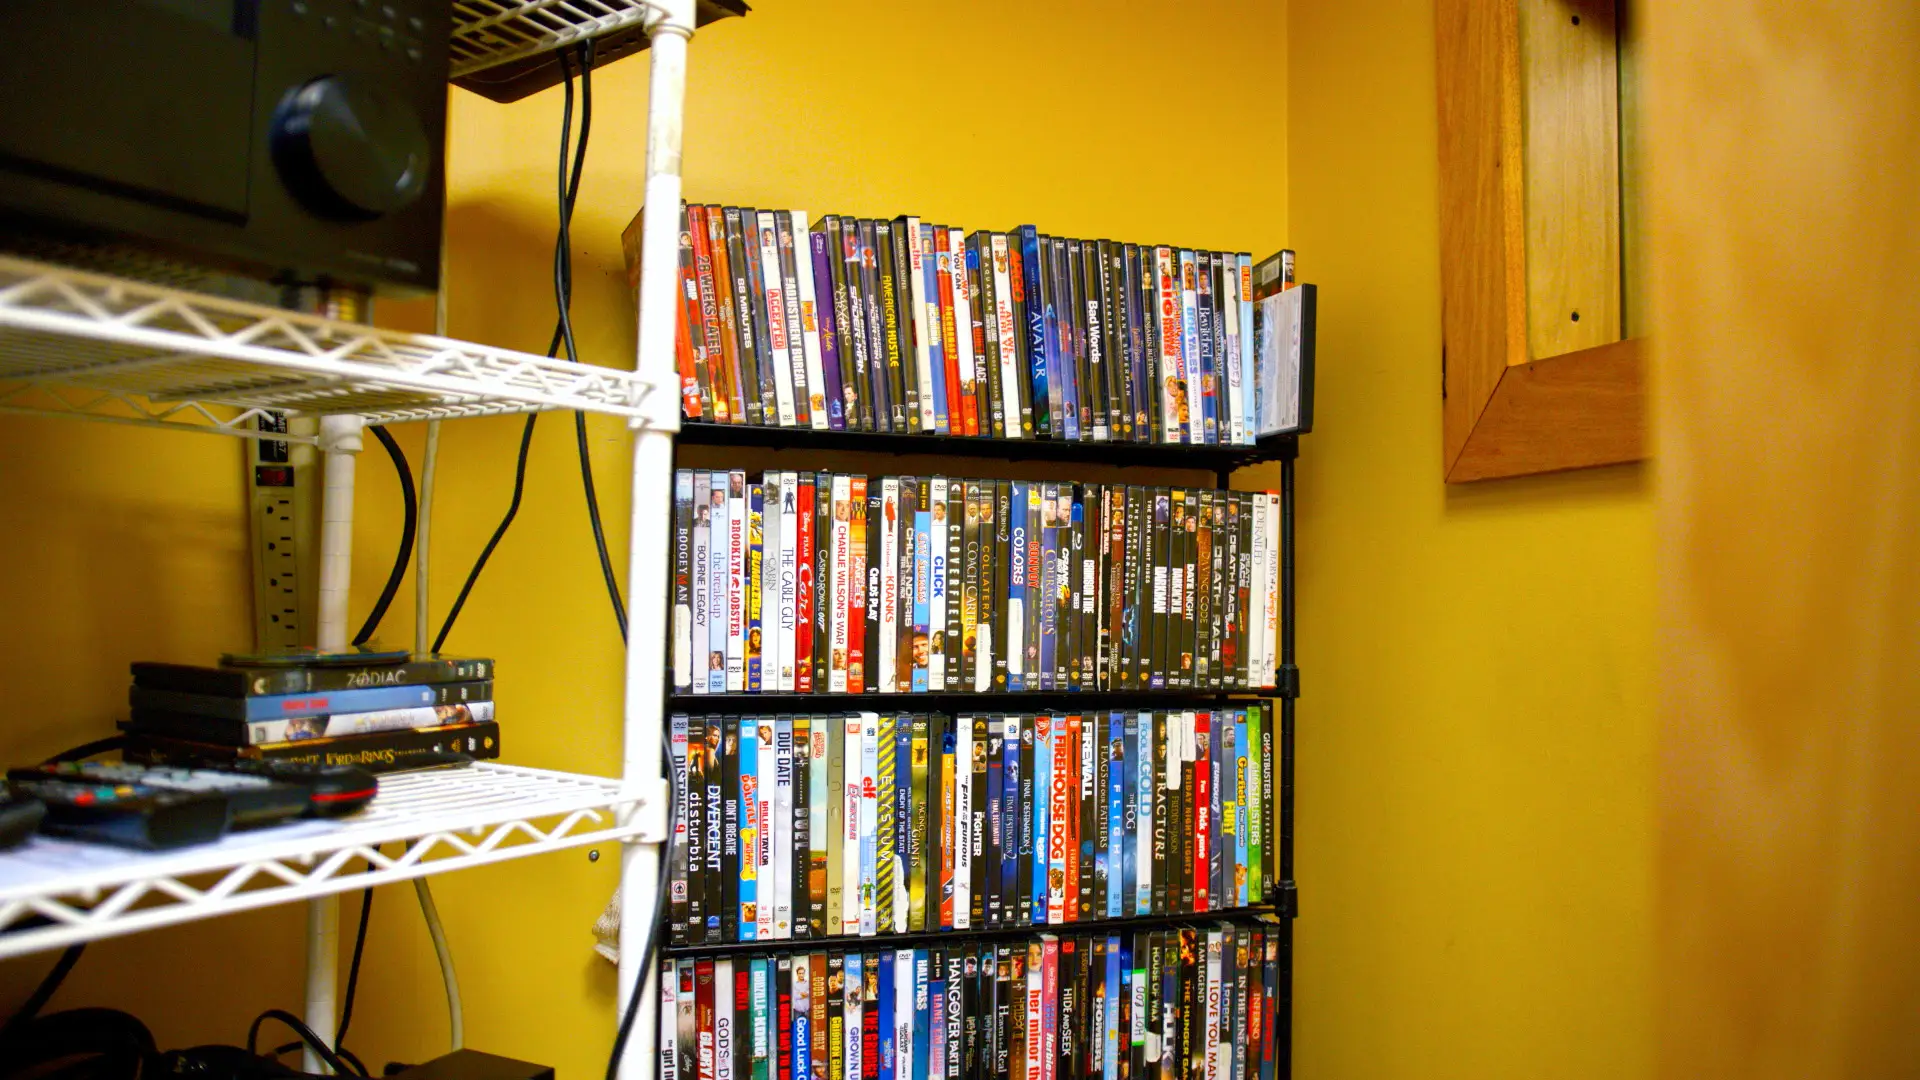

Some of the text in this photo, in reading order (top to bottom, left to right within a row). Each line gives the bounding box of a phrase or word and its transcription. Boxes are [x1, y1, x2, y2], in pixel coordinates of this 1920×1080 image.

[913, 250, 922, 270] that
[1009, 249, 1024, 302] ARGO
[697, 256, 722, 355] 28 WEEKS LATER
[740, 296, 751, 348] MINUTES
[770, 291, 785, 348] ACCEPTED
[850, 285, 864, 373] SPIDER-MAN
[882, 275, 899, 367] AMERICAN HUSTLE
[1088, 300, 1101, 364] Bad Words
[1199, 307, 1213, 357] Bewitched
[1214, 311, 1222, 341] WAKANDA
[785, 283, 805, 387] ADJUSTMENT BUREAU
[1030, 311, 1046, 379] AVATAR
[1188, 337, 1198, 374] TALES
[975, 355, 986, 384] PLACE
[678, 528, 688, 601] BOOGEYMAN
[730, 519, 740, 637] BROOKLYN LOBSTER
[933, 556, 943, 598] CLICK
[948, 525, 960, 637] CLOVERFIELD
[1013, 527, 1024, 584] COLORS
[1028, 541, 1039, 589] CONVOY
[696, 545, 705, 626] BOURNE LEGACY
[710, 552, 722, 618] the break-up
[751, 550, 761, 620] BUMBLEBEE
[782, 547, 793, 631] THE CABLE GUY
[799, 563, 812, 626] Cars
[836, 526, 846, 644] CHARLIE WILSON'S WAR
[867, 567, 879, 621] CHILD'S PLAY
[885, 576, 894, 622] KRANKS
[905, 581, 913, 626] NORRIS
[966, 541, 978, 631] COACH CARTER
[1044, 549, 1056, 635] COURAGEOUS
[1083, 560, 1094, 614] CRIMSON TIDE
[1153, 567, 1167, 613] DARKMAN
[1185, 564, 1195, 621] DATE NIGHT
[1200, 596, 1208, 624] CODE
[1212, 546, 1222, 661] DEATH RACE
[346, 669, 407, 687] ZODIAC
[326, 753, 352, 766] LORD
[361, 749, 395, 764] RINGS
[778, 732, 790, 786] DUE DATE
[1082, 721, 1092, 800] FIREWALL
[1238, 757, 1247, 806] Garfield
[1263, 733, 1271, 799] GHOSTBUSTERS
[741, 775, 757, 825] DOLITTLE
[863, 776, 876, 799] elf
[1052, 735, 1066, 859] FIREHOUSE DOG
[1141, 761, 1152, 816] GOLD
[1251, 762, 1259, 845] GHOSTBUSTERS
[674, 824, 686, 833] 9
[689, 792, 701, 872] disturbia
[707, 785, 720, 872] DIVERGENT
[725, 800, 736, 855] DON'T BREATHE
[795, 807, 808, 850] DUEL
[881, 776, 891, 861] ELYSIUM
[973, 811, 982, 856] FIGHTER
[1023, 802, 1031, 847] DESTINATION
[1100, 805, 1108, 848] FATHERS
[1113, 785, 1121, 869] FLIGHT
[1126, 804, 1137, 829] FOG
[1155, 772, 1166, 860] FRACTURE
[1184, 807, 1192, 837] NIGHT
[1199, 807, 1208, 830] Dick
[1223, 801, 1235, 836] FURY
[1198, 948, 1205, 962] AM
[916, 960, 928, 1010] HALL PASS
[948, 958, 960, 1064] HANGOVER PART
[1151, 947, 1159, 1022] HOUSE OF WAX
[1209, 987, 1218, 1016] LOVE
[718, 1018, 729, 1058] GOD'S
[998, 1005, 1008, 1073] Heaven Real
[1028, 990, 1041, 1061] her minor
[1062, 988, 1072, 1056] HIDE SEEK
[1135, 1015, 1145, 1036] HOT
[1162, 1002, 1175, 1060] HULK
[1236, 976, 1246, 1080] IN THE LINE OF FIR
[1252, 992, 1260, 1039] INFERNO
[662, 1049, 675, 1069] girl
[700, 1031, 712, 1076] GLORY
[797, 1017, 806, 1072] Good Luck
[850, 1027, 859, 1070] GROWN
[1045, 1032, 1054, 1070] Herbie
